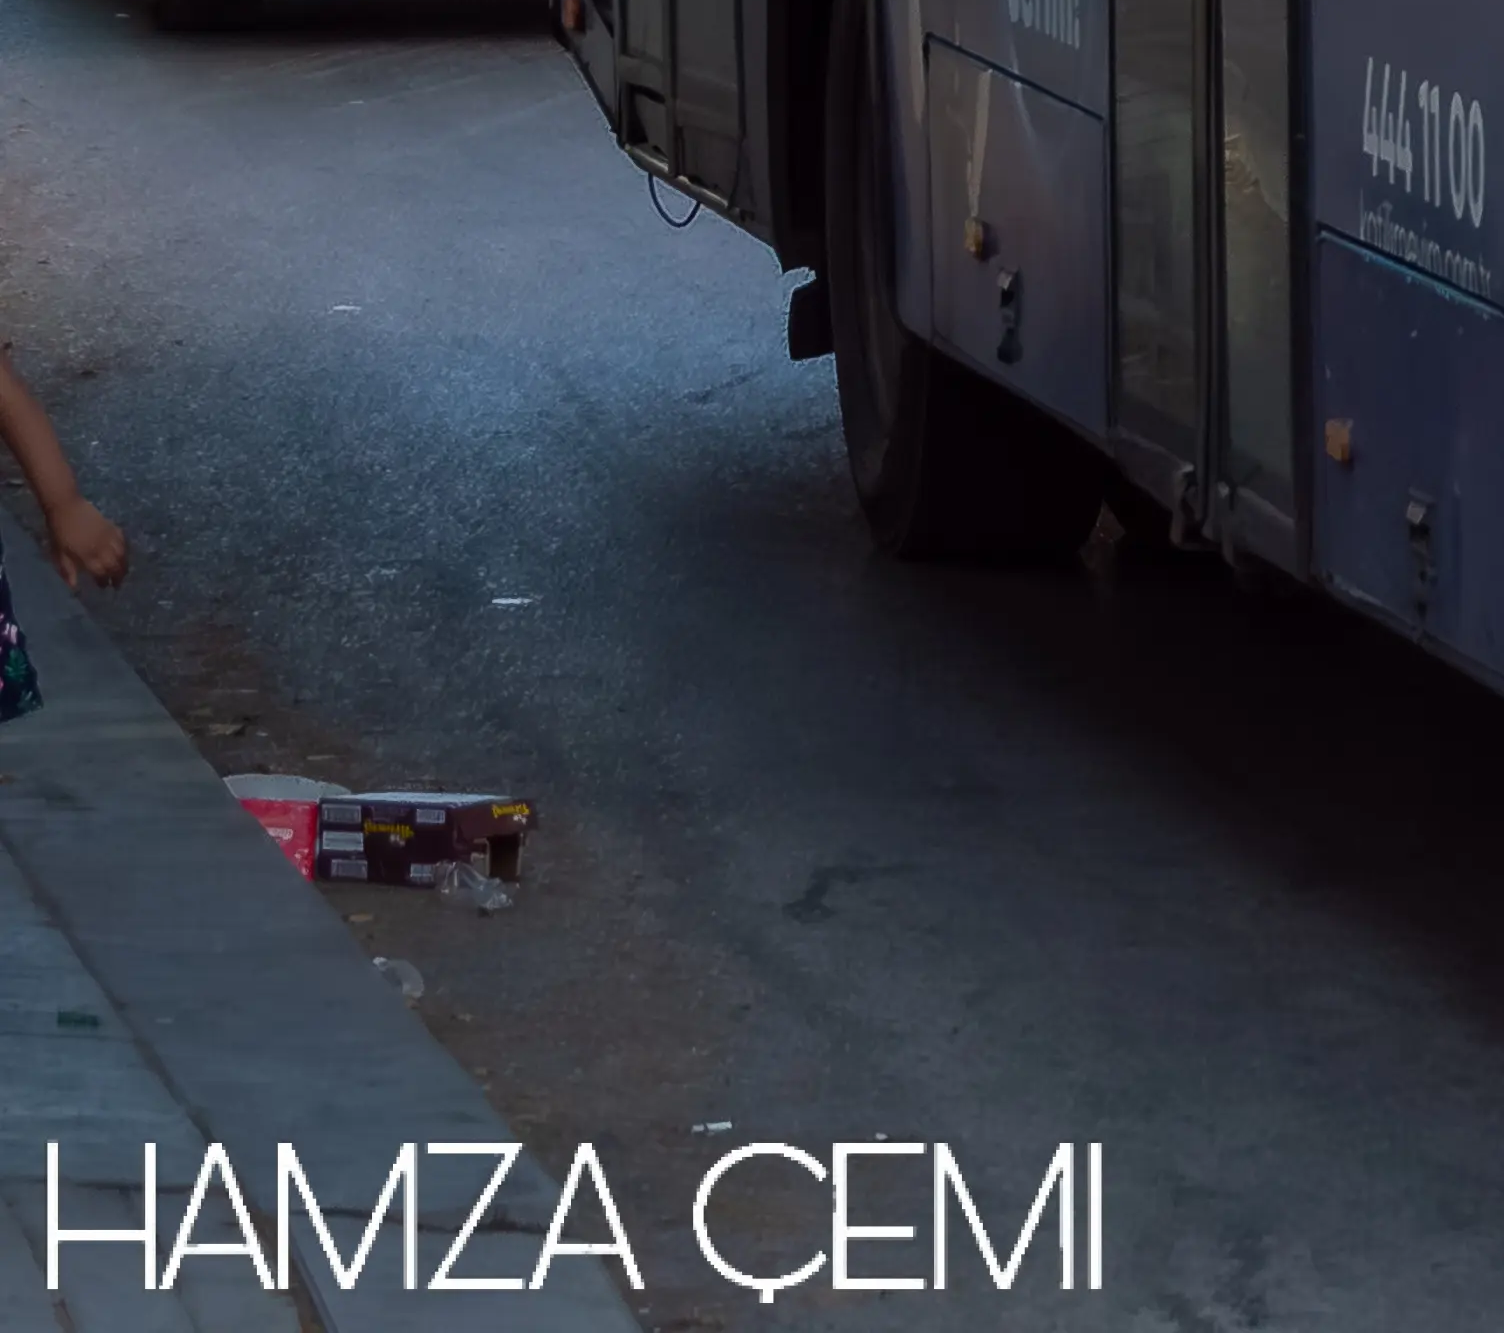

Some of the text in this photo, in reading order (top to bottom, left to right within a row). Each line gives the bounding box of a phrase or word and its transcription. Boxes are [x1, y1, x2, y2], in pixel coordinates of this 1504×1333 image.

[1363, 56, 1485, 229] 444 11 00
